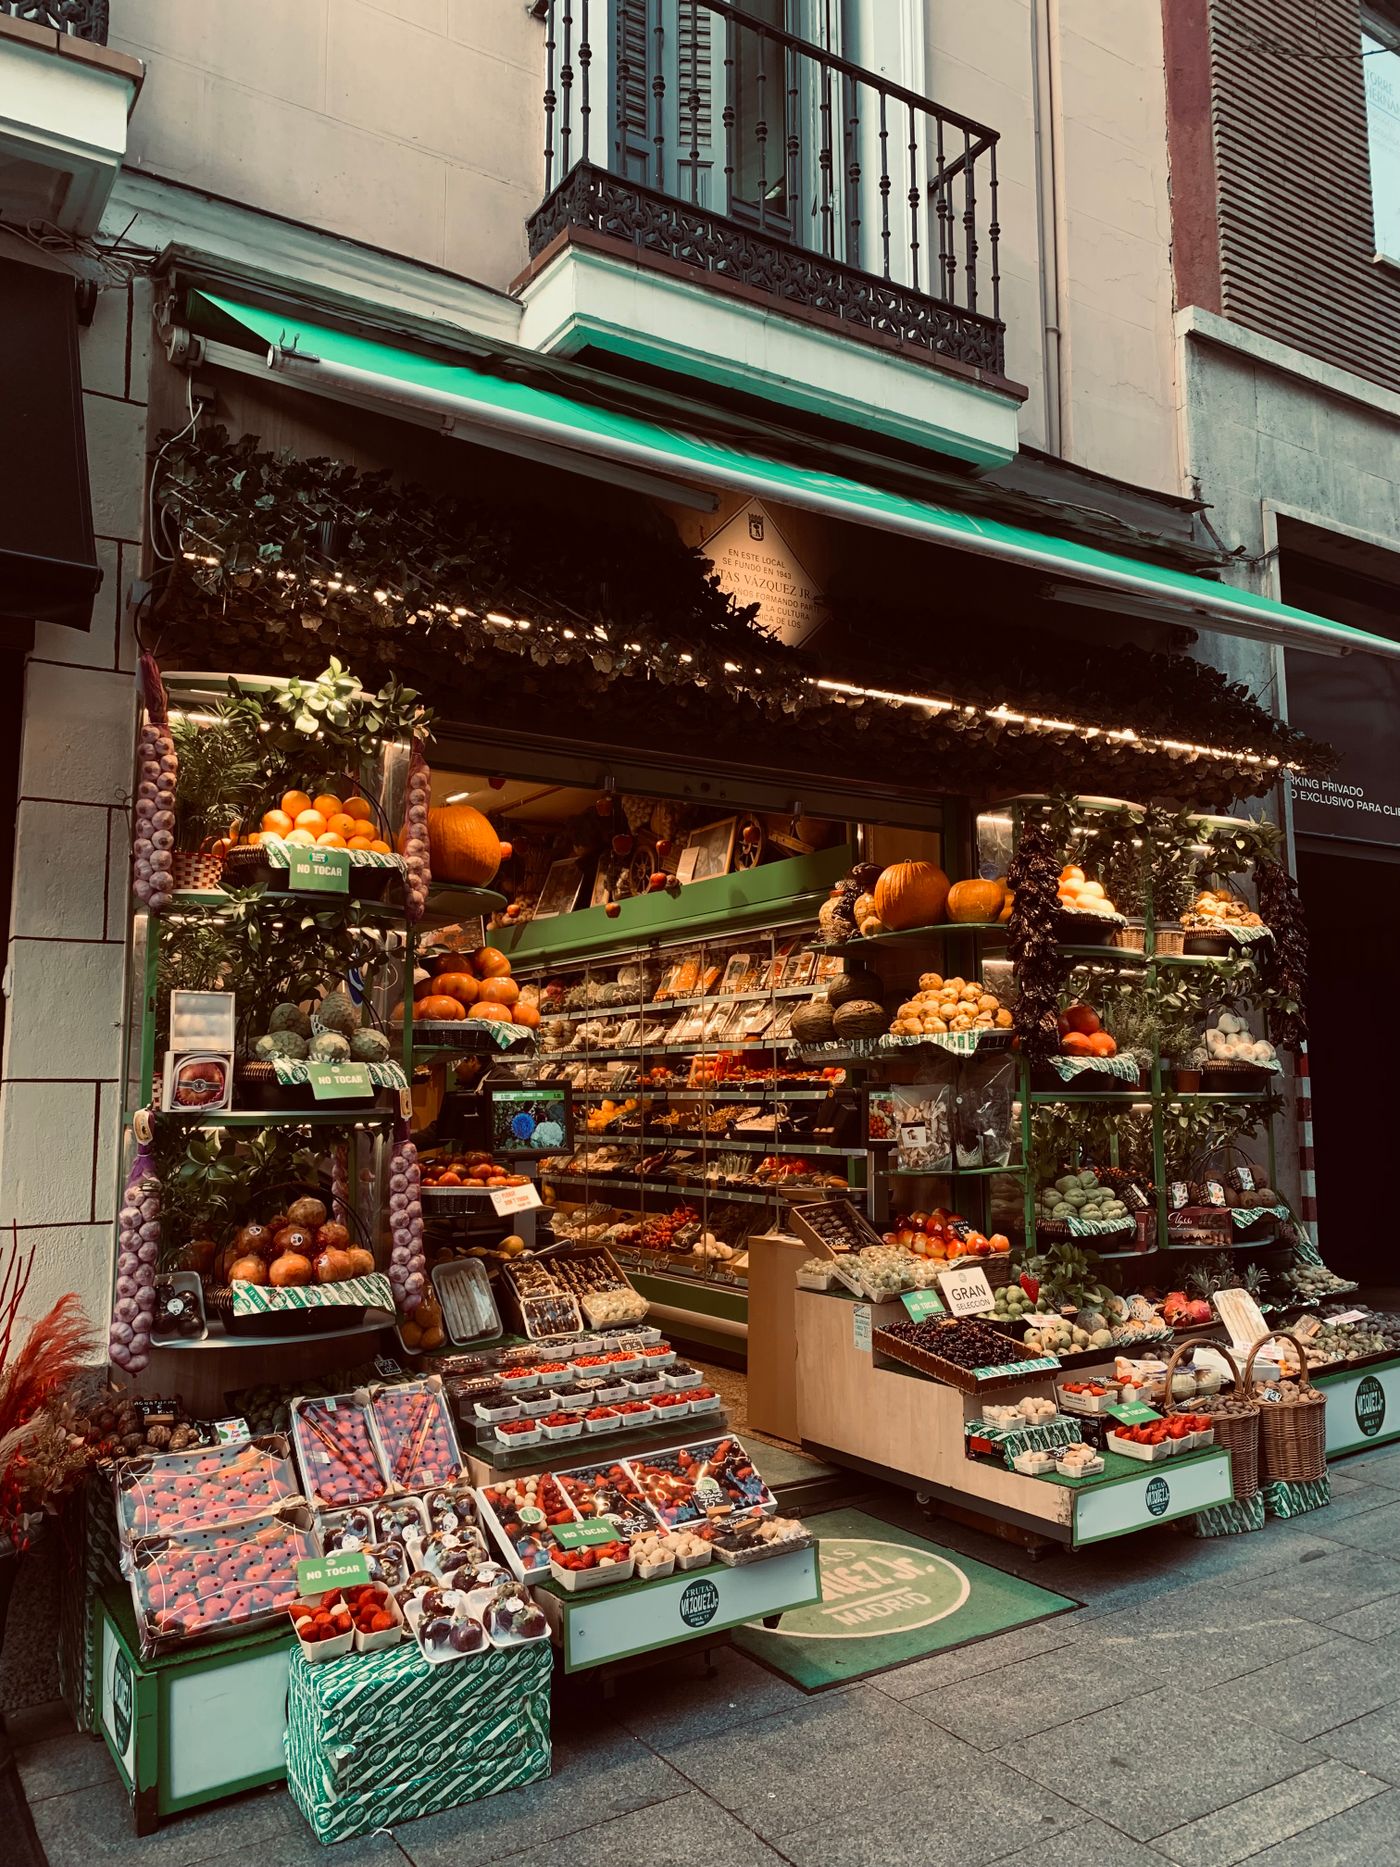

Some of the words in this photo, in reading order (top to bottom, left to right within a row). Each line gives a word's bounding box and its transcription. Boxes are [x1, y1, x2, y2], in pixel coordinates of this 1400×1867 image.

[728, 548, 739, 558] EN
[741, 551, 760, 563] ESTE
[762, 556, 785, 569] LOCAL
[722, 557, 731, 565] SE
[763, 567, 774, 576] EN
[776, 569, 792, 580] 1943
[744, 574, 797, 597] VÁZQUEZ
[755, 592, 799, 609] FORMANDO
[776, 616, 785, 625] DE
[787, 618, 801, 629] LOS
[777, 607, 810, 621] CULTURA
[1290, 775, 1319, 789] RKING
[1321, 781, 1364, 798] PRIVADO
[1300, 790, 1355, 809] EXCLUSIVO
[1356, 800, 1382, 813] PARA
[297, 863, 310, 874] NO
[313, 864, 343, 877] TOCAR
[318, 1076, 331, 1085] NO
[334, 1075, 363, 1084] TOCAR
[951, 1284, 987, 1301] GRAN
[910, 1302, 921, 1312] NO
[142, 1406, 150, 1415] 9
[1127, 1407, 1150, 1416] TOCAR
[562, 1531, 577, 1539] NO
[579, 1527, 609, 1537] TOCAR
[306, 1570, 322, 1581] NO
[325, 1564, 360, 1577] TOCAR
[686, 1583, 714, 1598] FRUTAS
[681, 1592, 711, 1617] VAZQUEZ
[831, 1592, 932, 1626] MADRID
